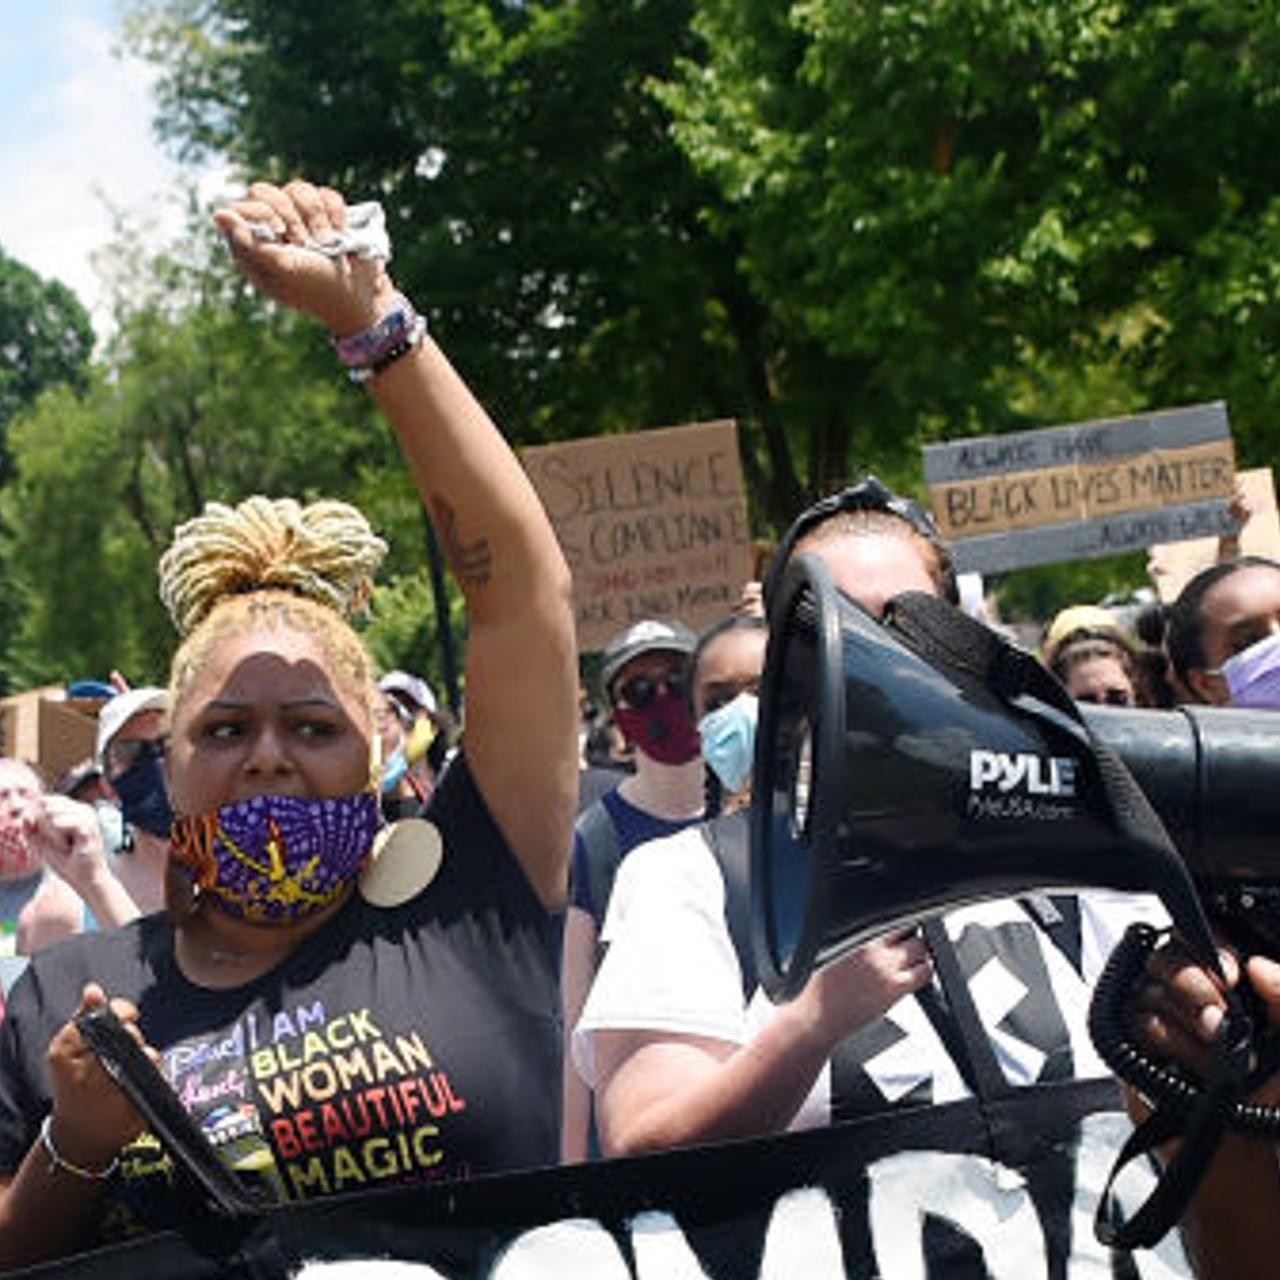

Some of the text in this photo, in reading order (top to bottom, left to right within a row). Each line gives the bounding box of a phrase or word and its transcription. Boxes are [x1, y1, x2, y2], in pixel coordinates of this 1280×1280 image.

[540, 452, 740, 515] SILENCE
[946, 455, 1231, 529] BLACK LIVES MATTER
[970, 750, 1078, 796] PYLE
[250, 1006, 383, 1080] BLACK
[272, 1000, 328, 1044] AM
[258, 1030, 435, 1114] WOMAN
[270, 1071, 468, 1161] BEAUTIFUL
[287, 1127, 447, 1196] MAGIC
